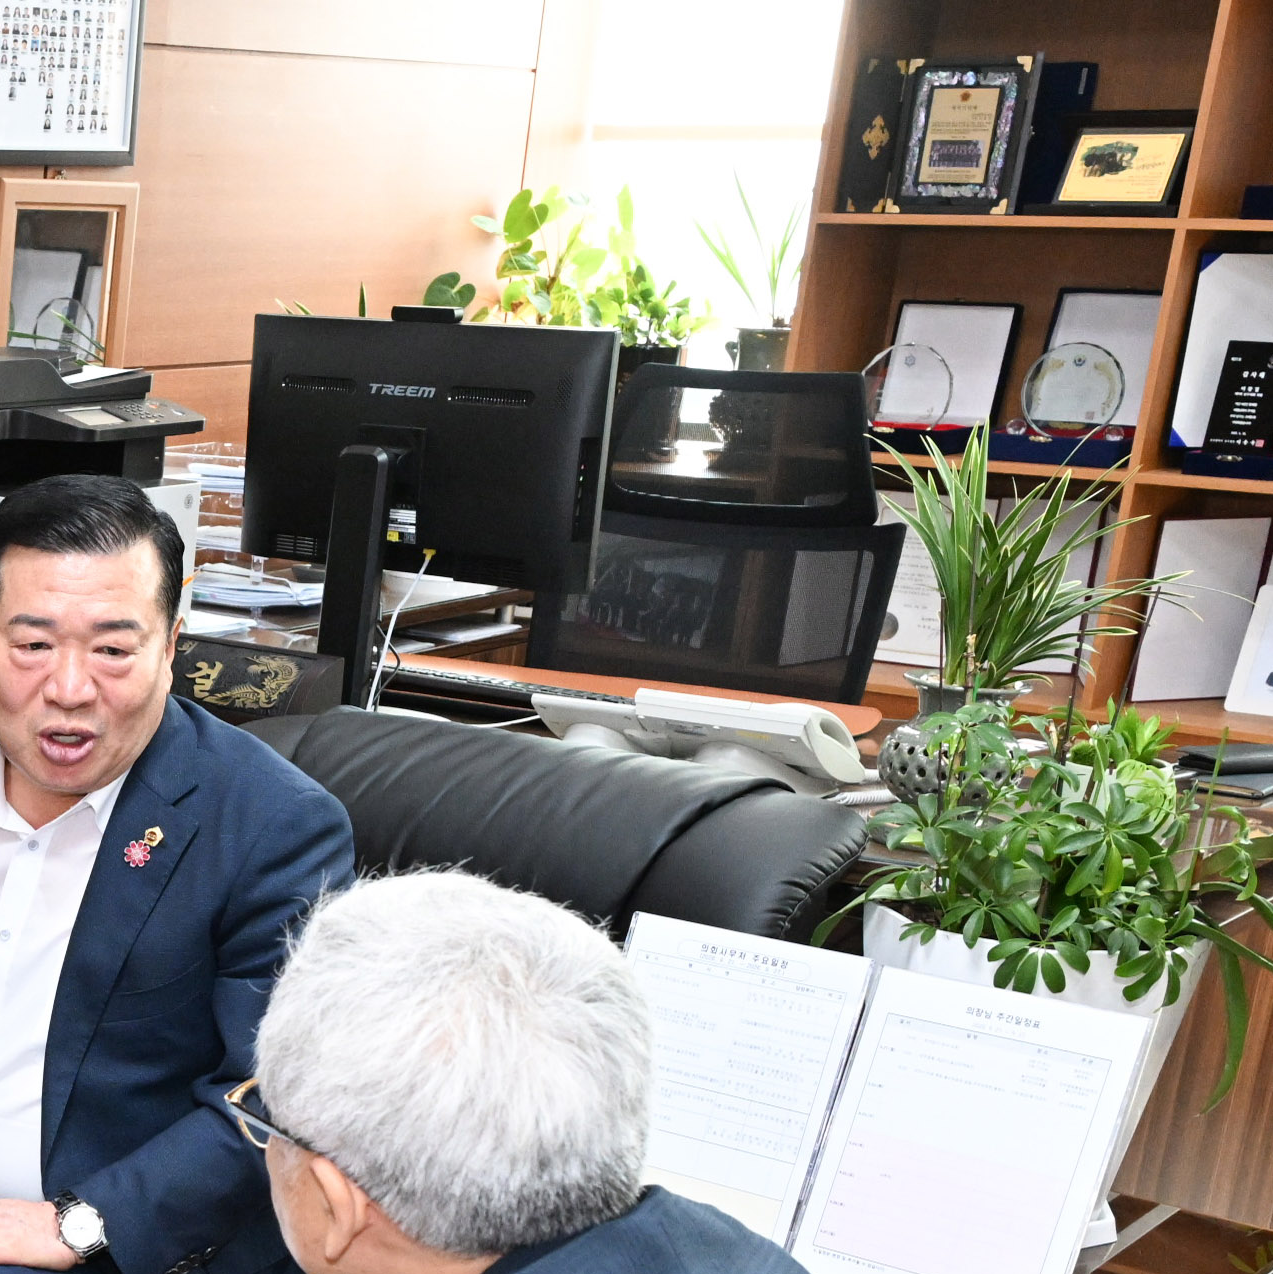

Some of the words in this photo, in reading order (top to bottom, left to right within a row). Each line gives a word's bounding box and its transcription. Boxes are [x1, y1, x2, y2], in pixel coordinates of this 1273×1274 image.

[369, 383, 436, 398] TREEM
[965, 1005, 992, 1020] 의장님
[996, 1012, 1041, 1030] 주간일정표
